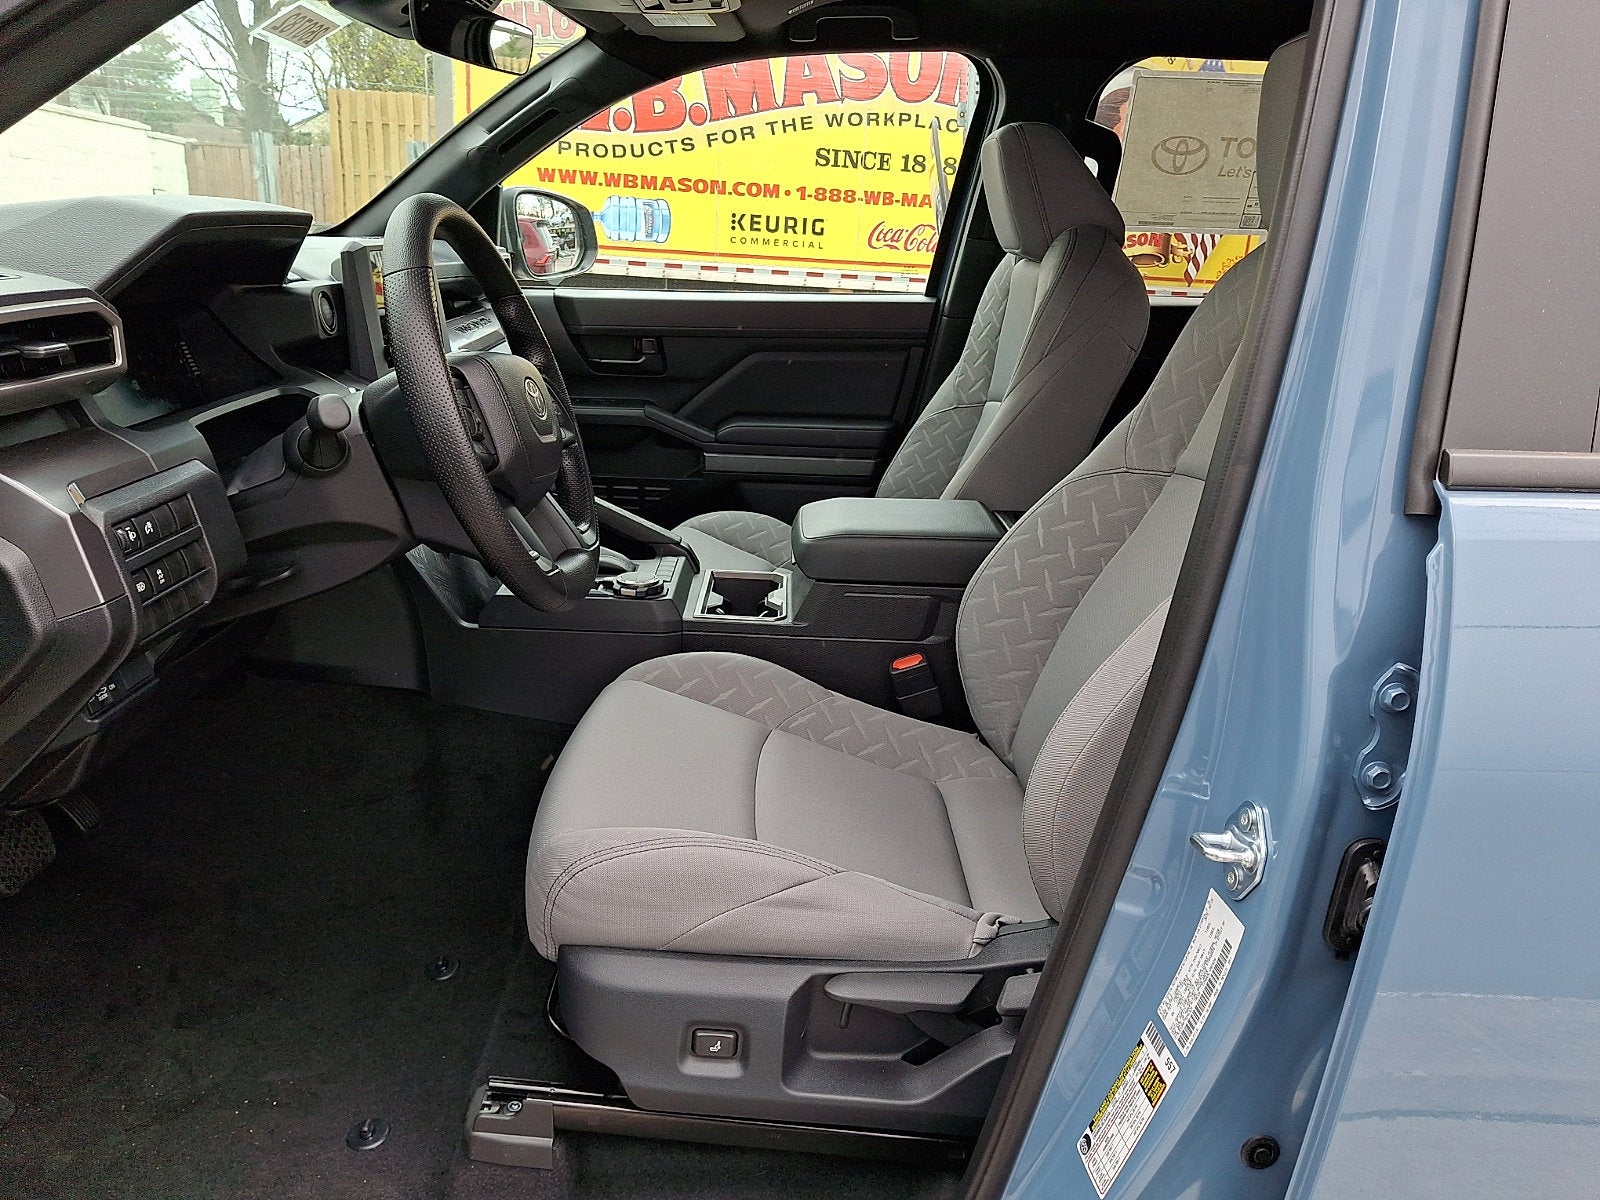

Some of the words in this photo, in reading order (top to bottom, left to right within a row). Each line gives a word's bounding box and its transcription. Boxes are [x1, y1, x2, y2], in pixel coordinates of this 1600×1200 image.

[558, 137, 696, 159] PRODUCTS
[706, 126, 756, 147] FOR
[766, 115, 814, 136] THE
[815, 147, 891, 171] SINCE
[900, 154, 957, 176] 188
[1217, 165, 1252, 178] Let's
[536, 167, 780, 199] WWW.WBMASON.COM
[731, 213, 825, 236] KEURIG
[730, 236, 824, 250] COMMERCIAL
[1122, 232, 1164, 248] SON
